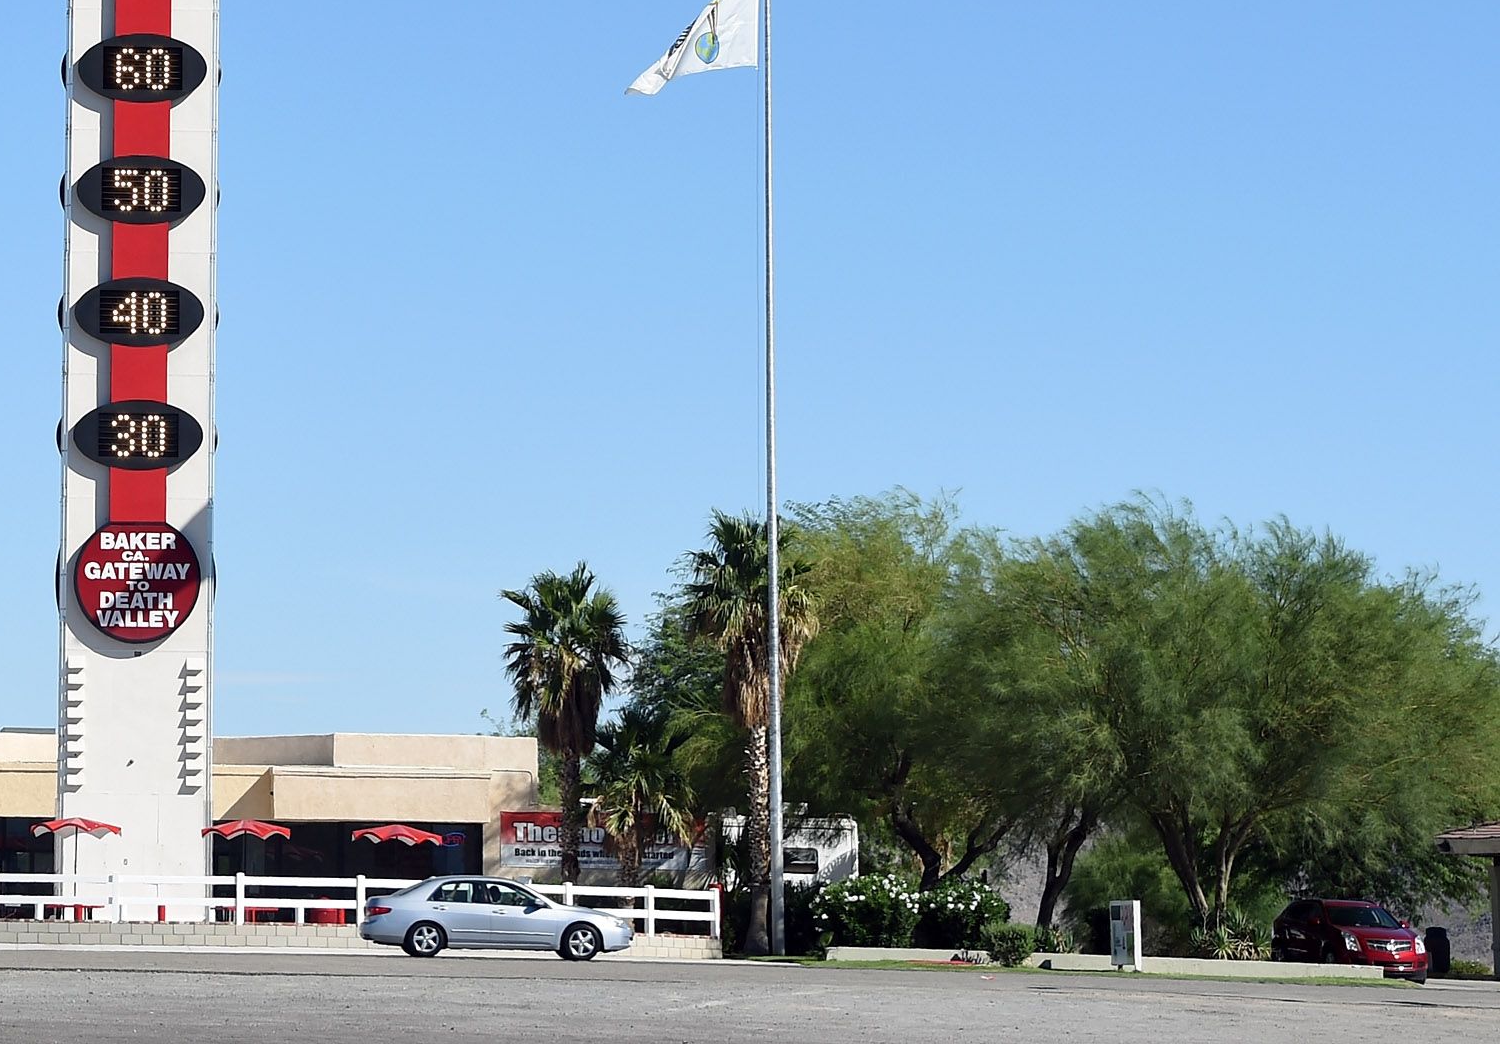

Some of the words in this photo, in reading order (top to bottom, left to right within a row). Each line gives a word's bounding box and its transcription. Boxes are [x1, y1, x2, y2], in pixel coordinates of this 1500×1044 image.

[115, 48, 171, 90] 60
[114, 169, 169, 212] 50
[112, 291, 167, 335] 40
[111, 414, 166, 458] 30
[100, 532, 176, 550] BAKER
[121, 551, 150, 562] CA.
[84, 562, 191, 580] GATEWAY
[126, 581, 150, 591] TO
[99, 591, 173, 609] DEATH
[96, 610, 180, 628] VALLEY
[514, 847, 536, 857] Back
[537, 847, 547, 857] in
[548, 847, 562, 857] the
